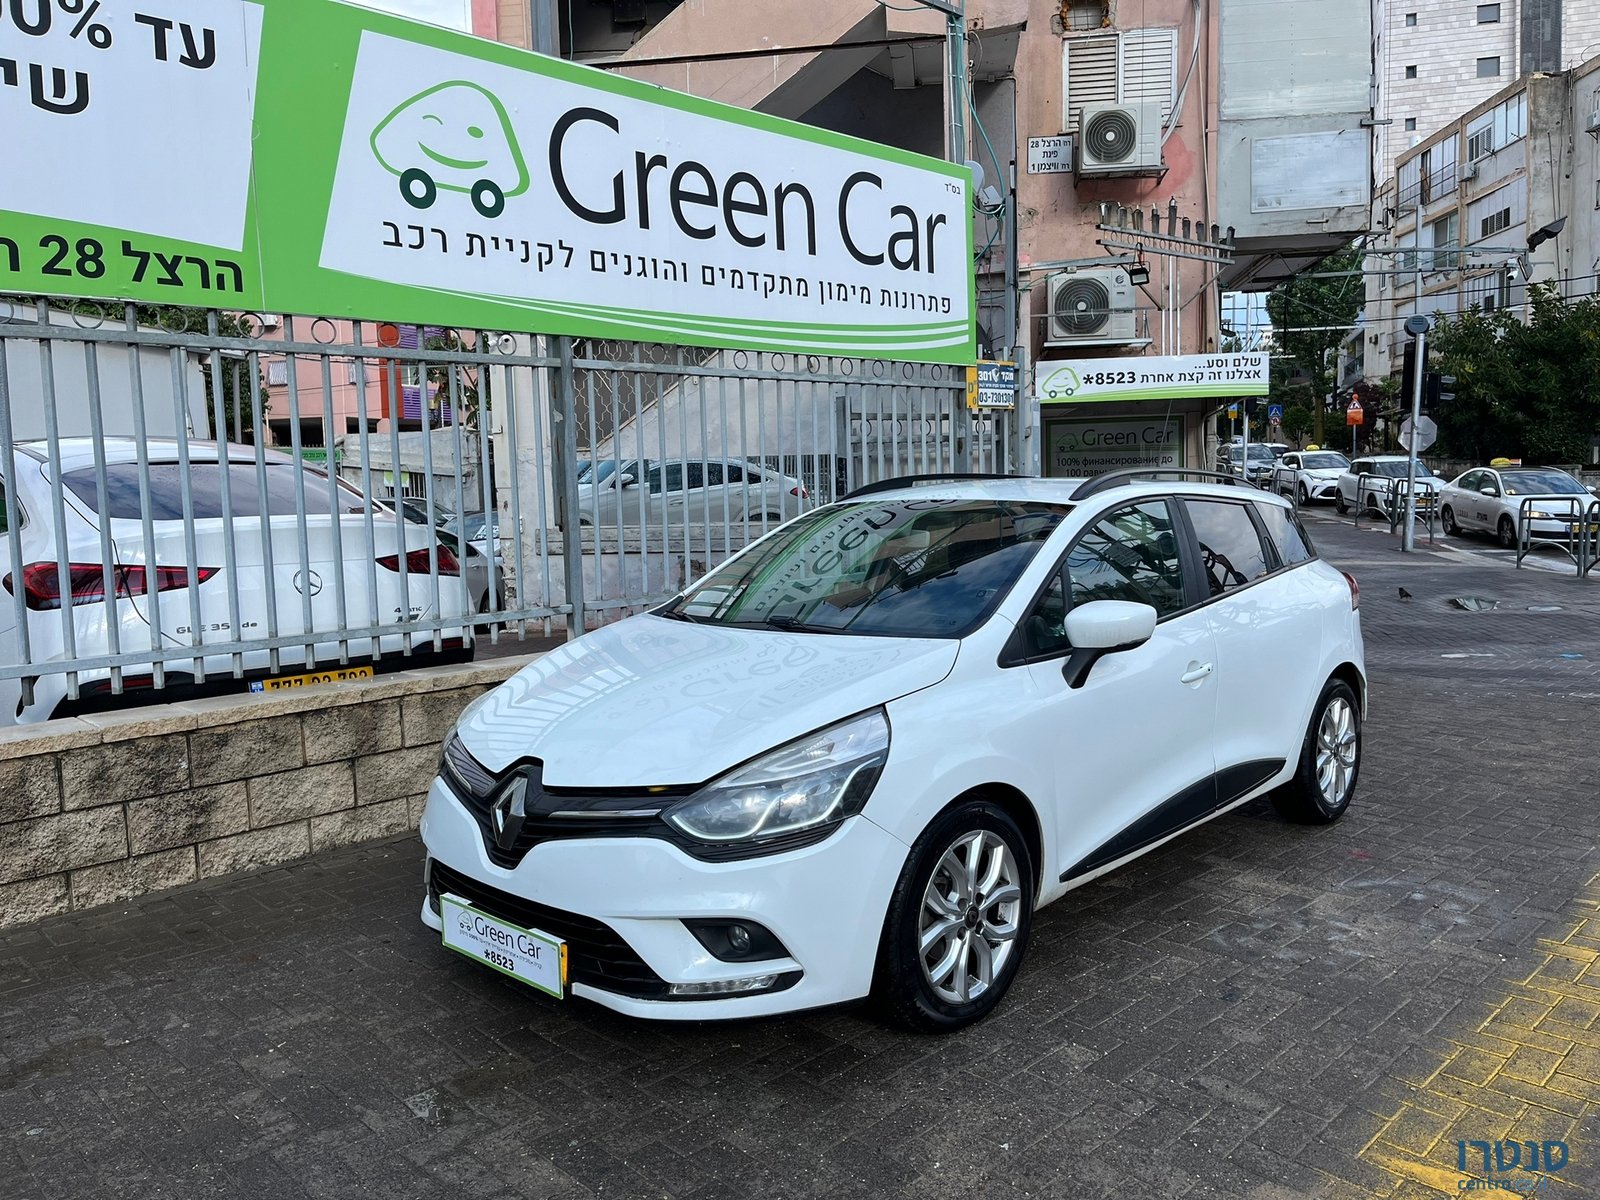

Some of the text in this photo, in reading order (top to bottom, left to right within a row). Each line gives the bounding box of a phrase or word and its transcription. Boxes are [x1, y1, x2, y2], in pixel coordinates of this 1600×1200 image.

[134, 12, 216, 70] עד
[1041, 139, 1061, 147] הרצל
[548, 106, 947, 274] Green Car
[38, 233, 106, 279] 28
[121, 239, 244, 293] הרצל
[382, 220, 952, 314] פתרונות מימון מתקדמים והוגנים לקניית רכב
[1232, 355, 1262, 367] שלם
[978, 370, 992, 381] 301
[1140, 372, 1173, 383] אחרת
[1177, 371, 1204, 384] קצת
[1208, 370, 1222, 380] זה
[1226, 368, 1261, 380] אצלנו
[1081, 426, 1174, 446] Green Car
[1056, 455, 1173, 467] 100% финансирование до
[1065, 468, 1082, 478] 100
[241, 621, 258, 629] de
[474, 916, 514, 949] Green
[517, 934, 541, 960] Car
